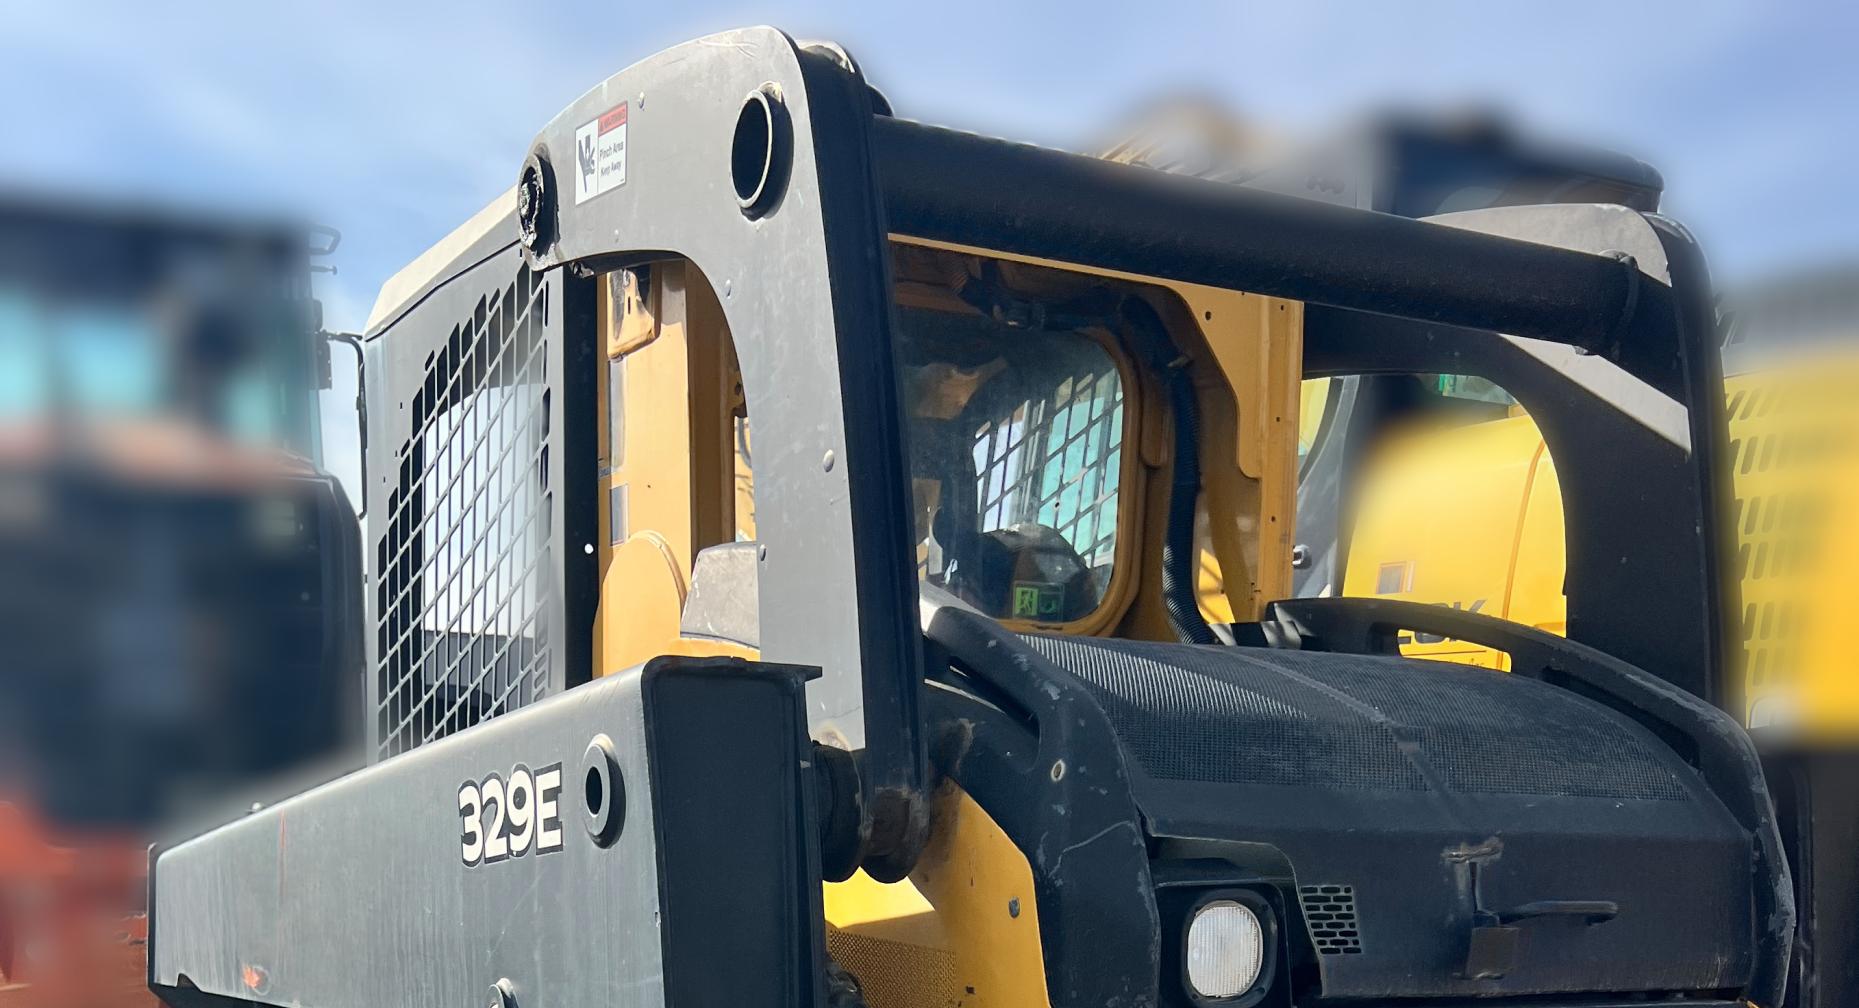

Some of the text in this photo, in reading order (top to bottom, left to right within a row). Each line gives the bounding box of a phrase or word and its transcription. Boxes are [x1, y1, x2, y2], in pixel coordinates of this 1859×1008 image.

[600, 141, 624, 161] Pinch Area
[601, 161, 622, 177] Keep Away
[458, 763, 563, 866] 329E
